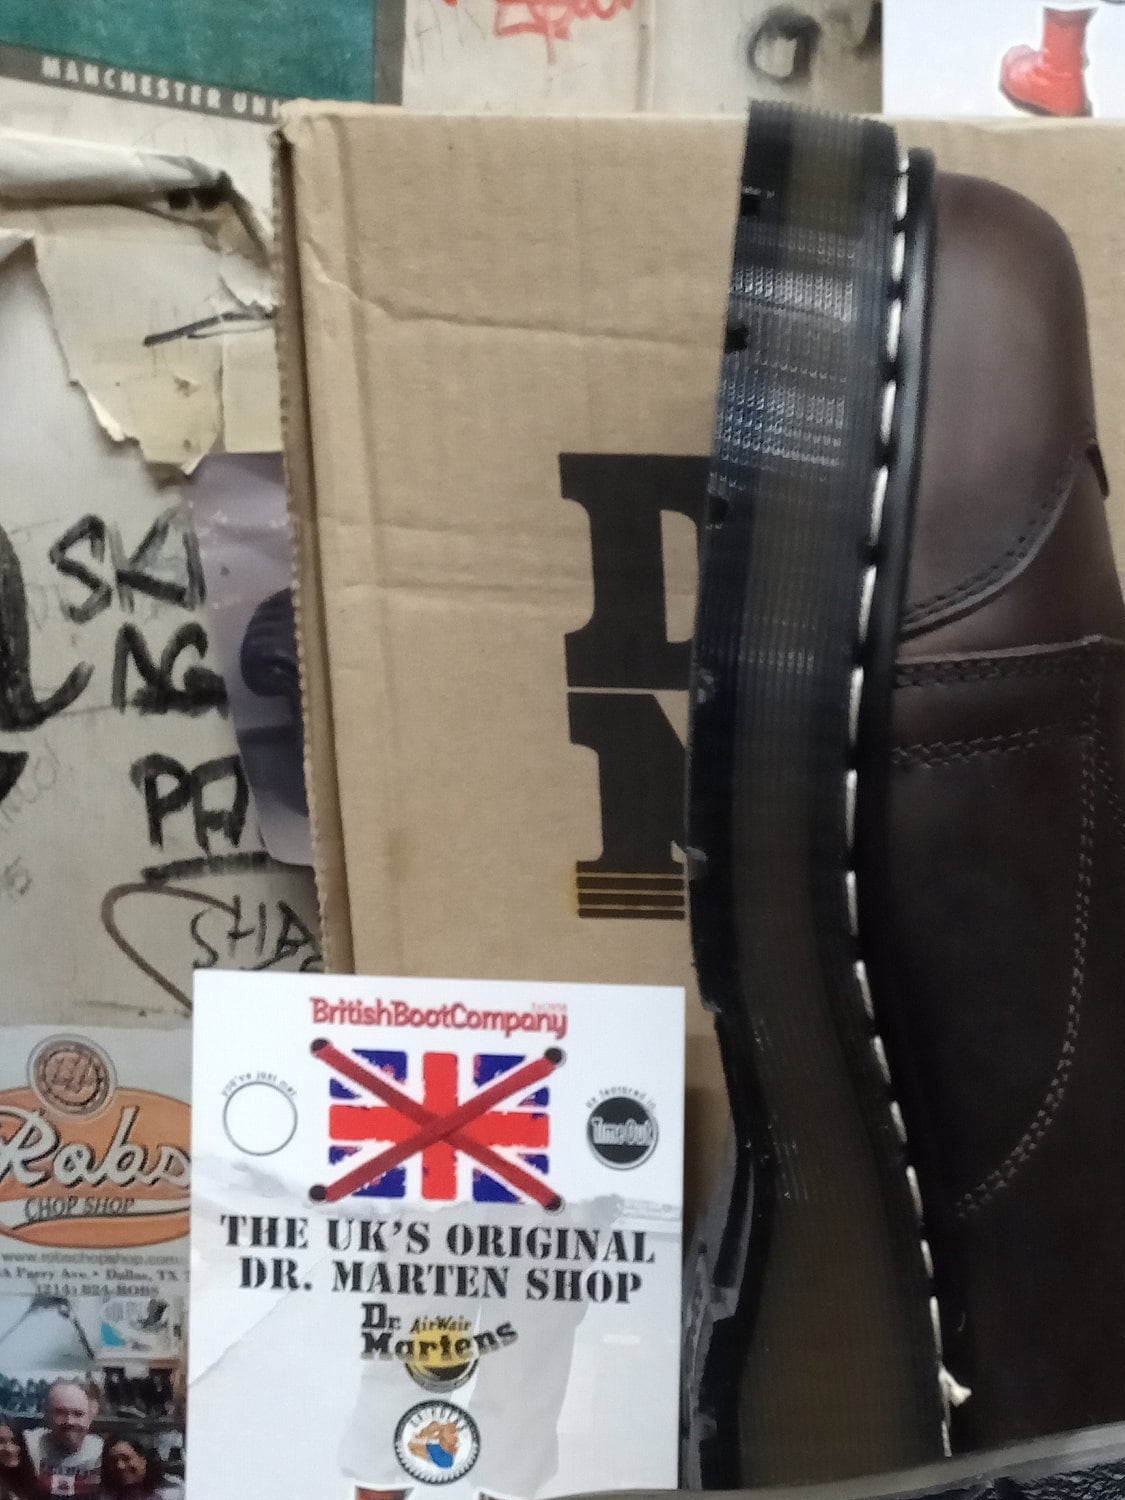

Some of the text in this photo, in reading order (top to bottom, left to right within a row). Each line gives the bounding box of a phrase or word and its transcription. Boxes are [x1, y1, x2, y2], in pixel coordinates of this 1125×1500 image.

[40, 55, 221, 109] MANCHESTER
[24, 1195, 136, 1222] CHOP SHOP
[220, 1214, 656, 1264] THE UK'S ORIGINAL
[239, 1255, 643, 1304] DR. MARTEN SHOP
[361, 1321, 518, 1360] Martens
